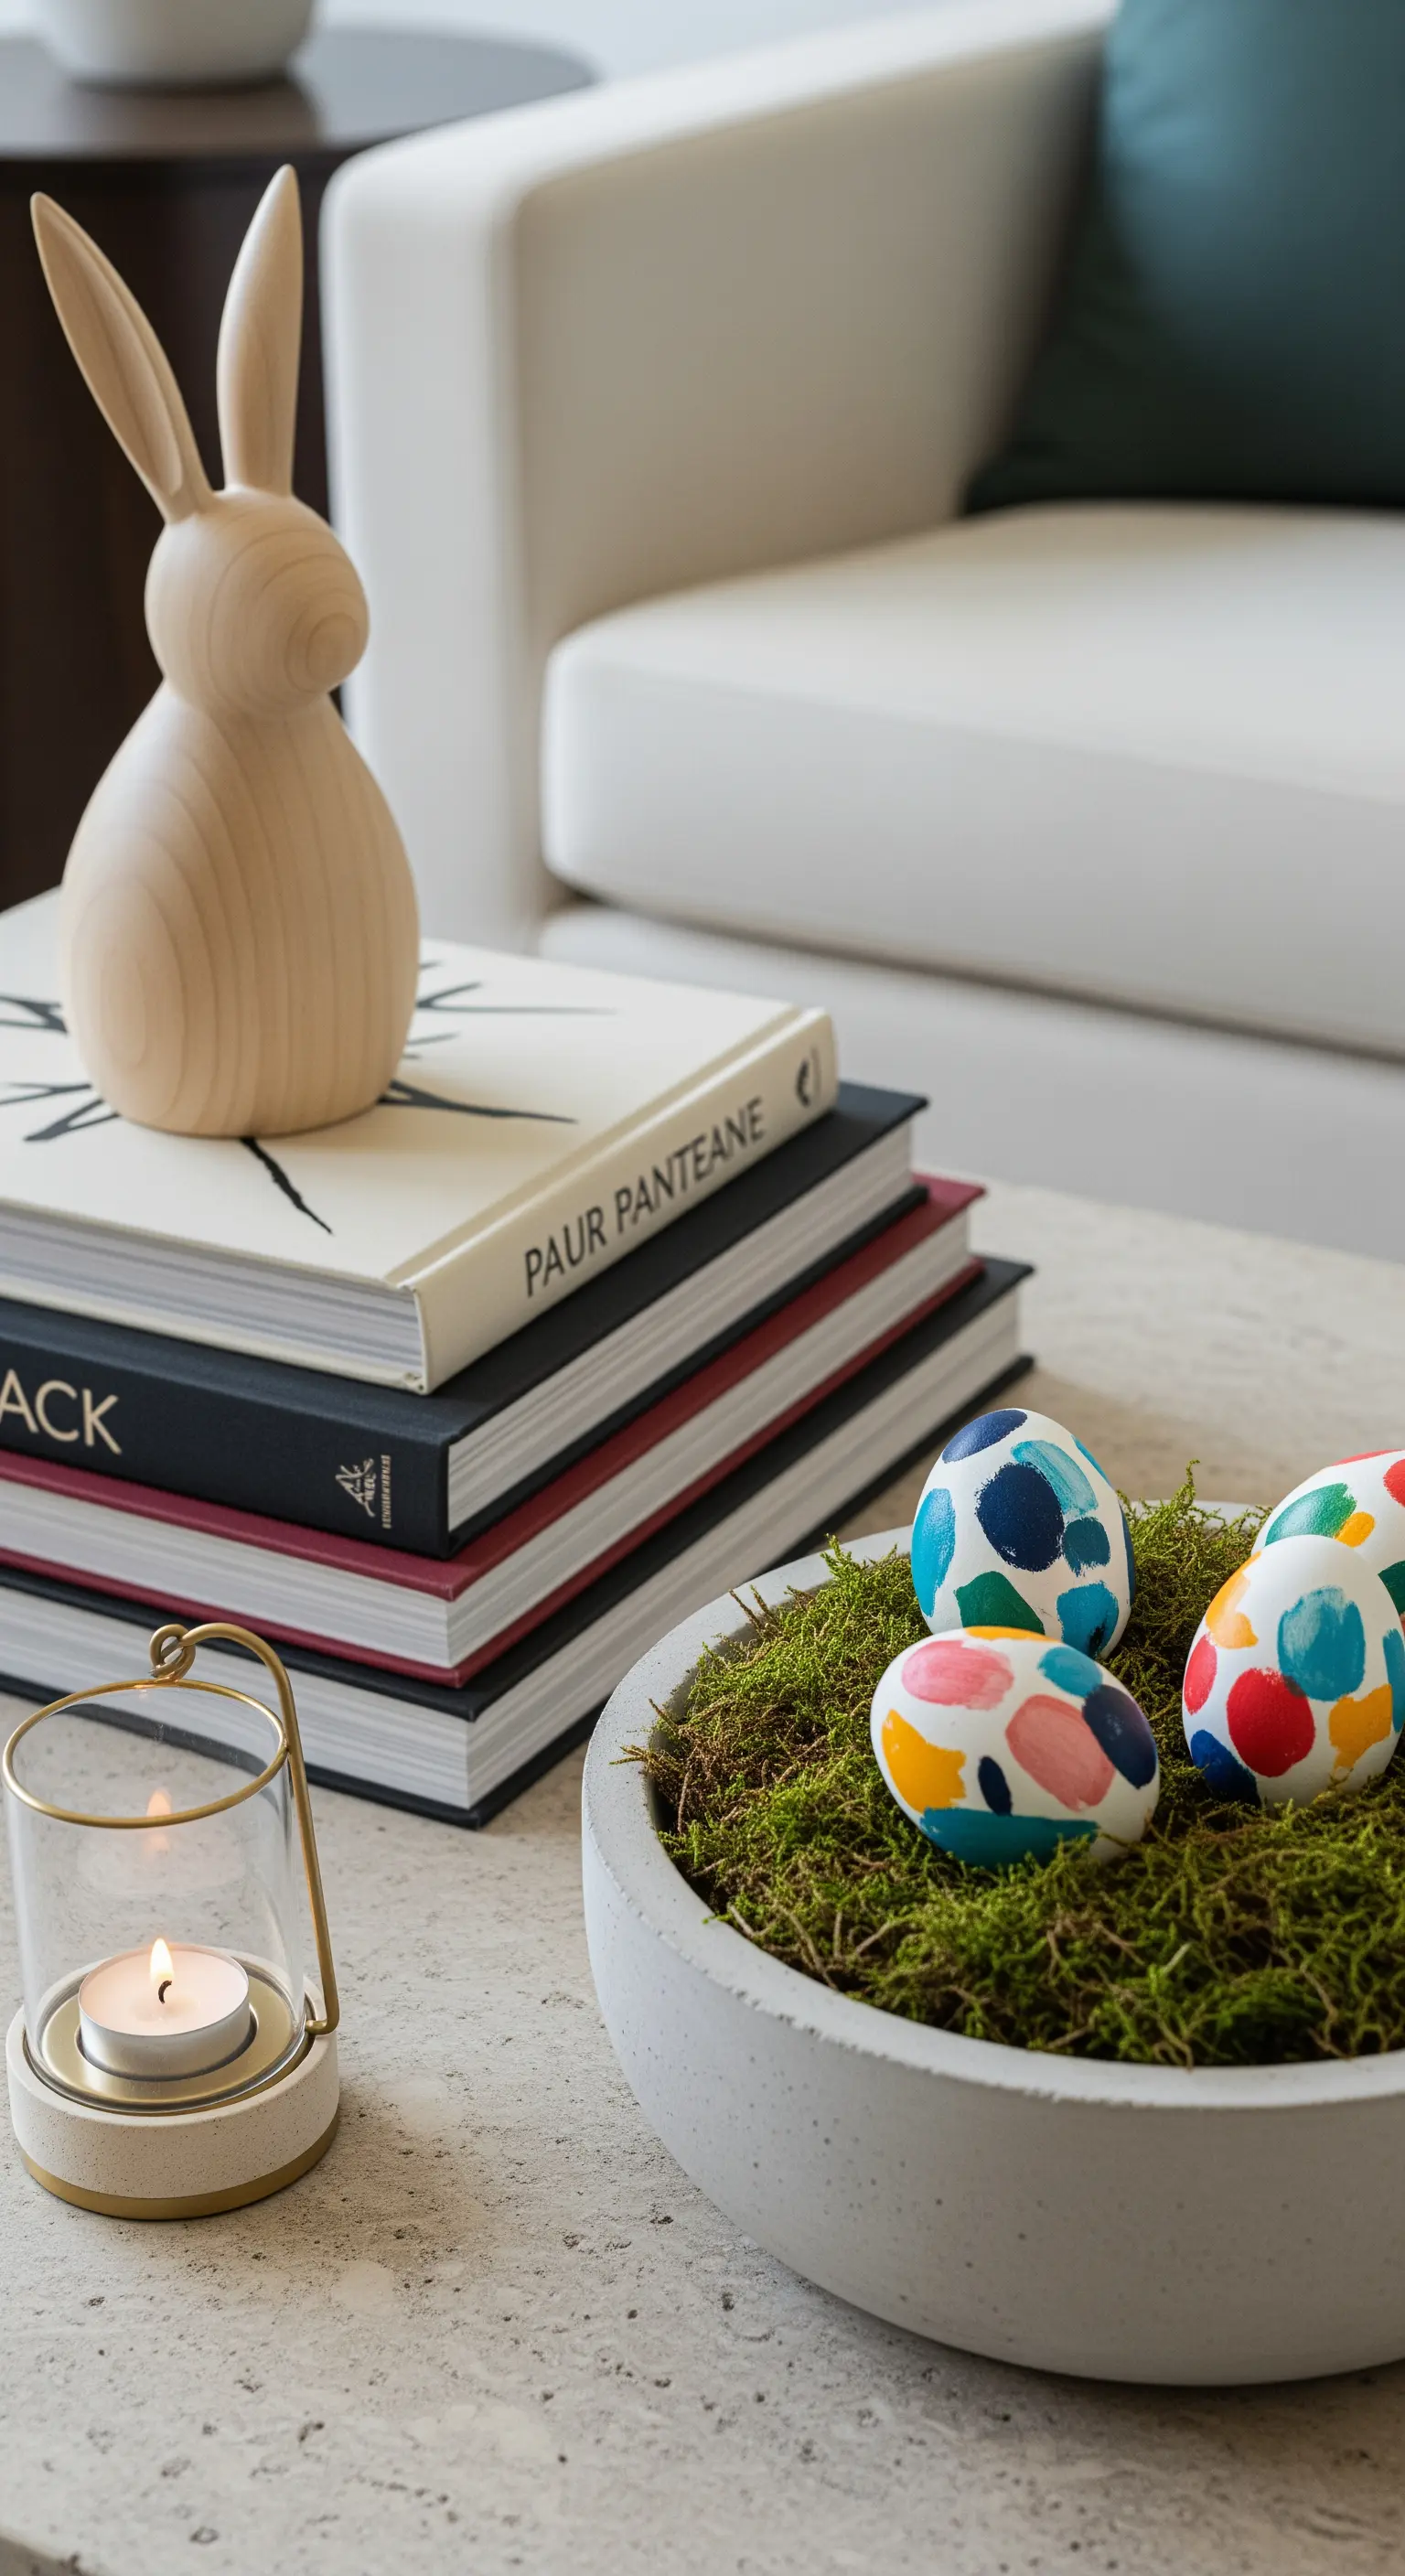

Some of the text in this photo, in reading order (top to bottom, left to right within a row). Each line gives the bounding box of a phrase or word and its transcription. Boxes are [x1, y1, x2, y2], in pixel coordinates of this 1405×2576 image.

[524, 1096, 766, 1298] PAUR PANTEANE
[0, 1368, 122, 1454] ACK
